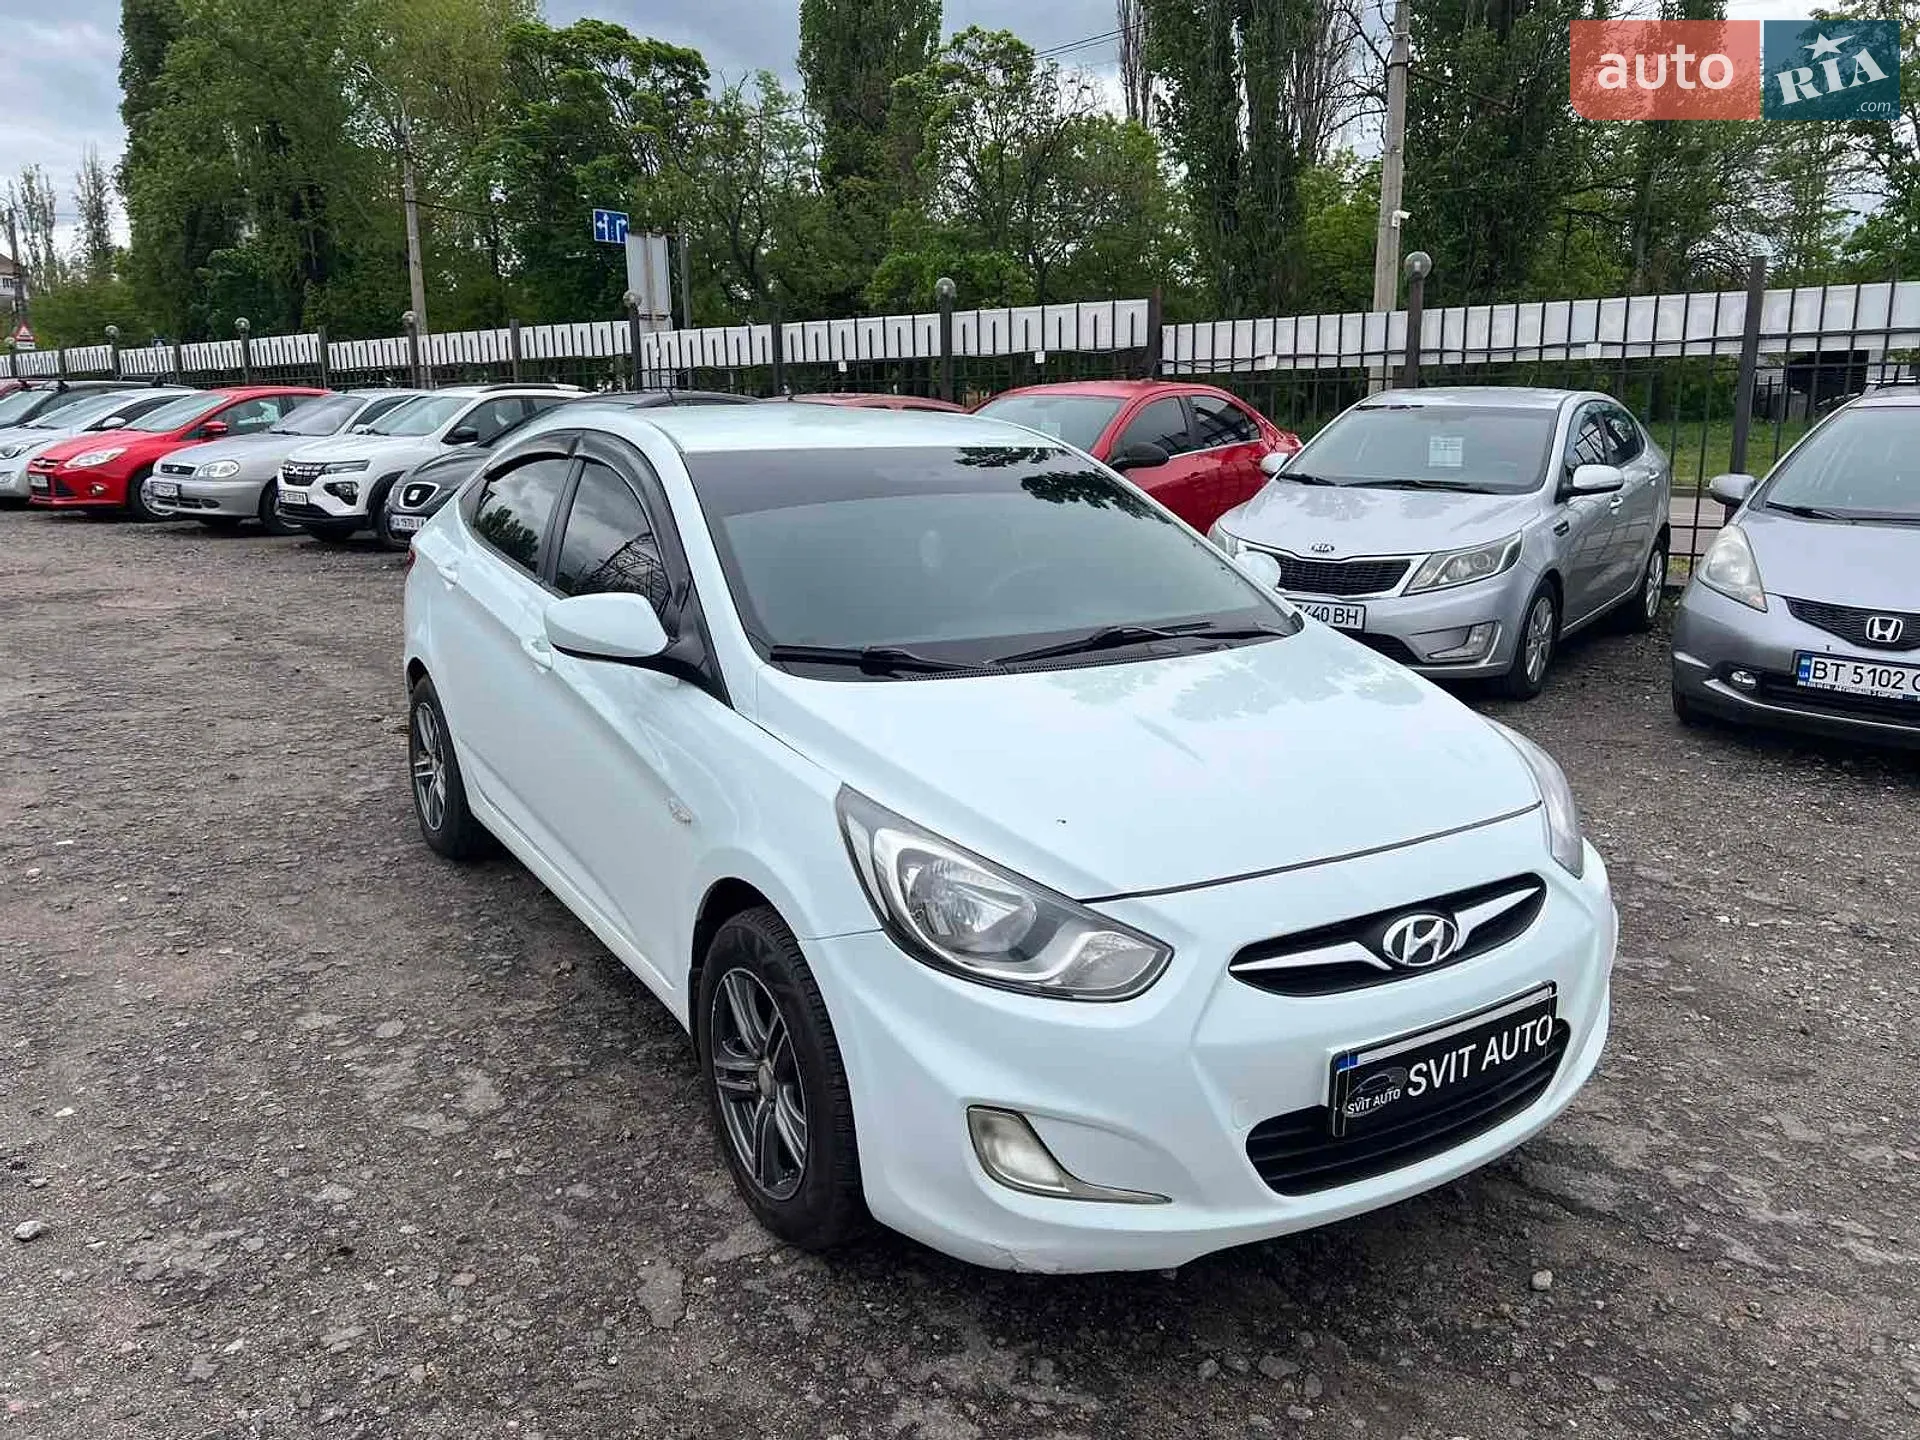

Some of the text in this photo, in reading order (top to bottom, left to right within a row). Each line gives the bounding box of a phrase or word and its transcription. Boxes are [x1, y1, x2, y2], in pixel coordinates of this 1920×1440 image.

[1333, 607, 1359, 625] BH
[1812, 660, 1846, 682] BT
[1851, 665, 1906, 690] 5102
[1408, 1015, 1553, 1097] SVIT AUTO
[1347, 1088, 1401, 1114] SVIT AUTO
